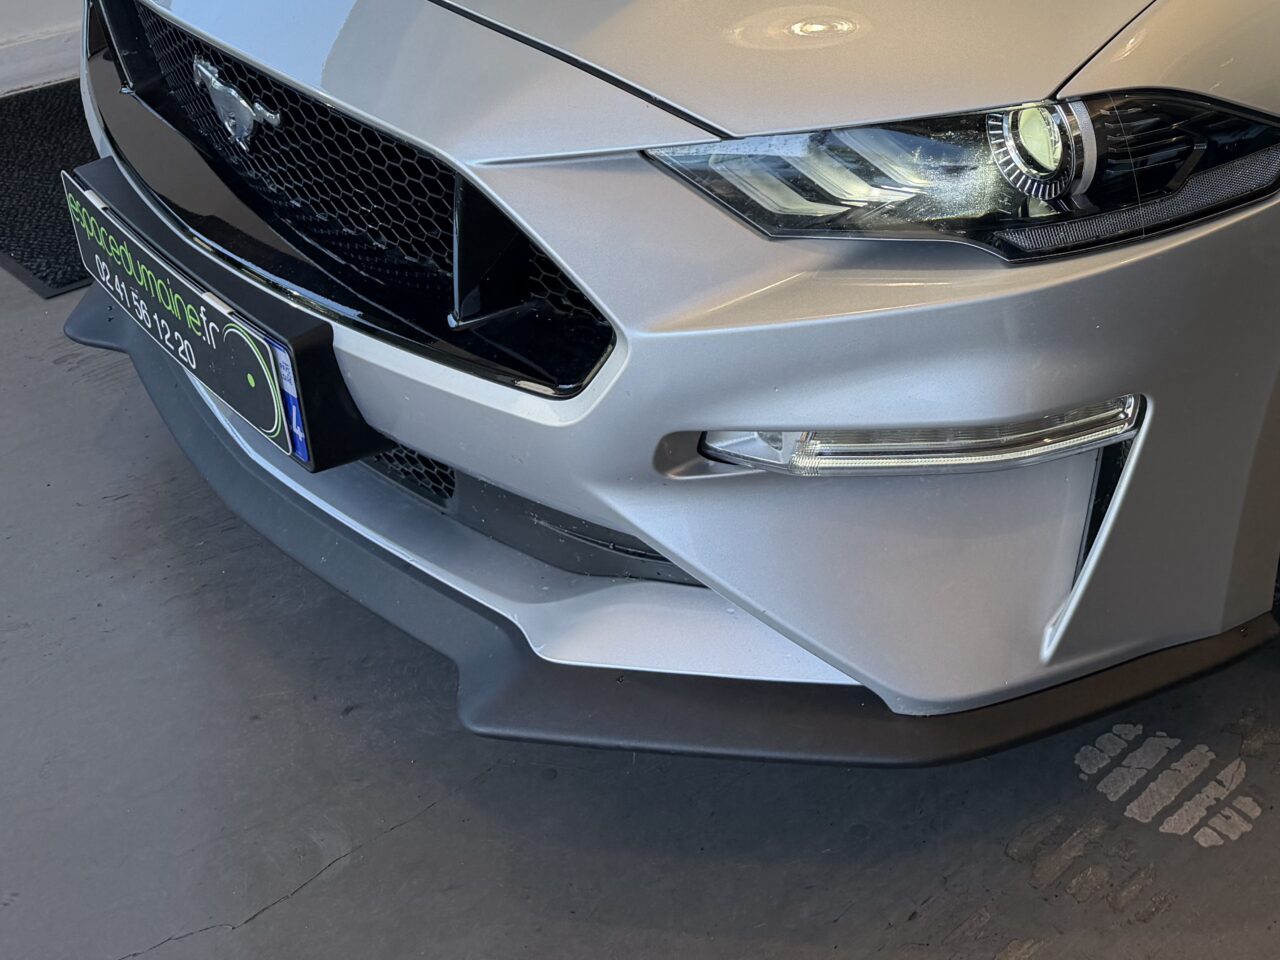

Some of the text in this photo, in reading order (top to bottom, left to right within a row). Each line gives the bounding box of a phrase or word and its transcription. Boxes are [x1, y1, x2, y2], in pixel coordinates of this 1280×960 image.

[68, 192, 220, 349] espacedumaine.fr
[95, 253, 197, 370] 02 41 56 12 20
